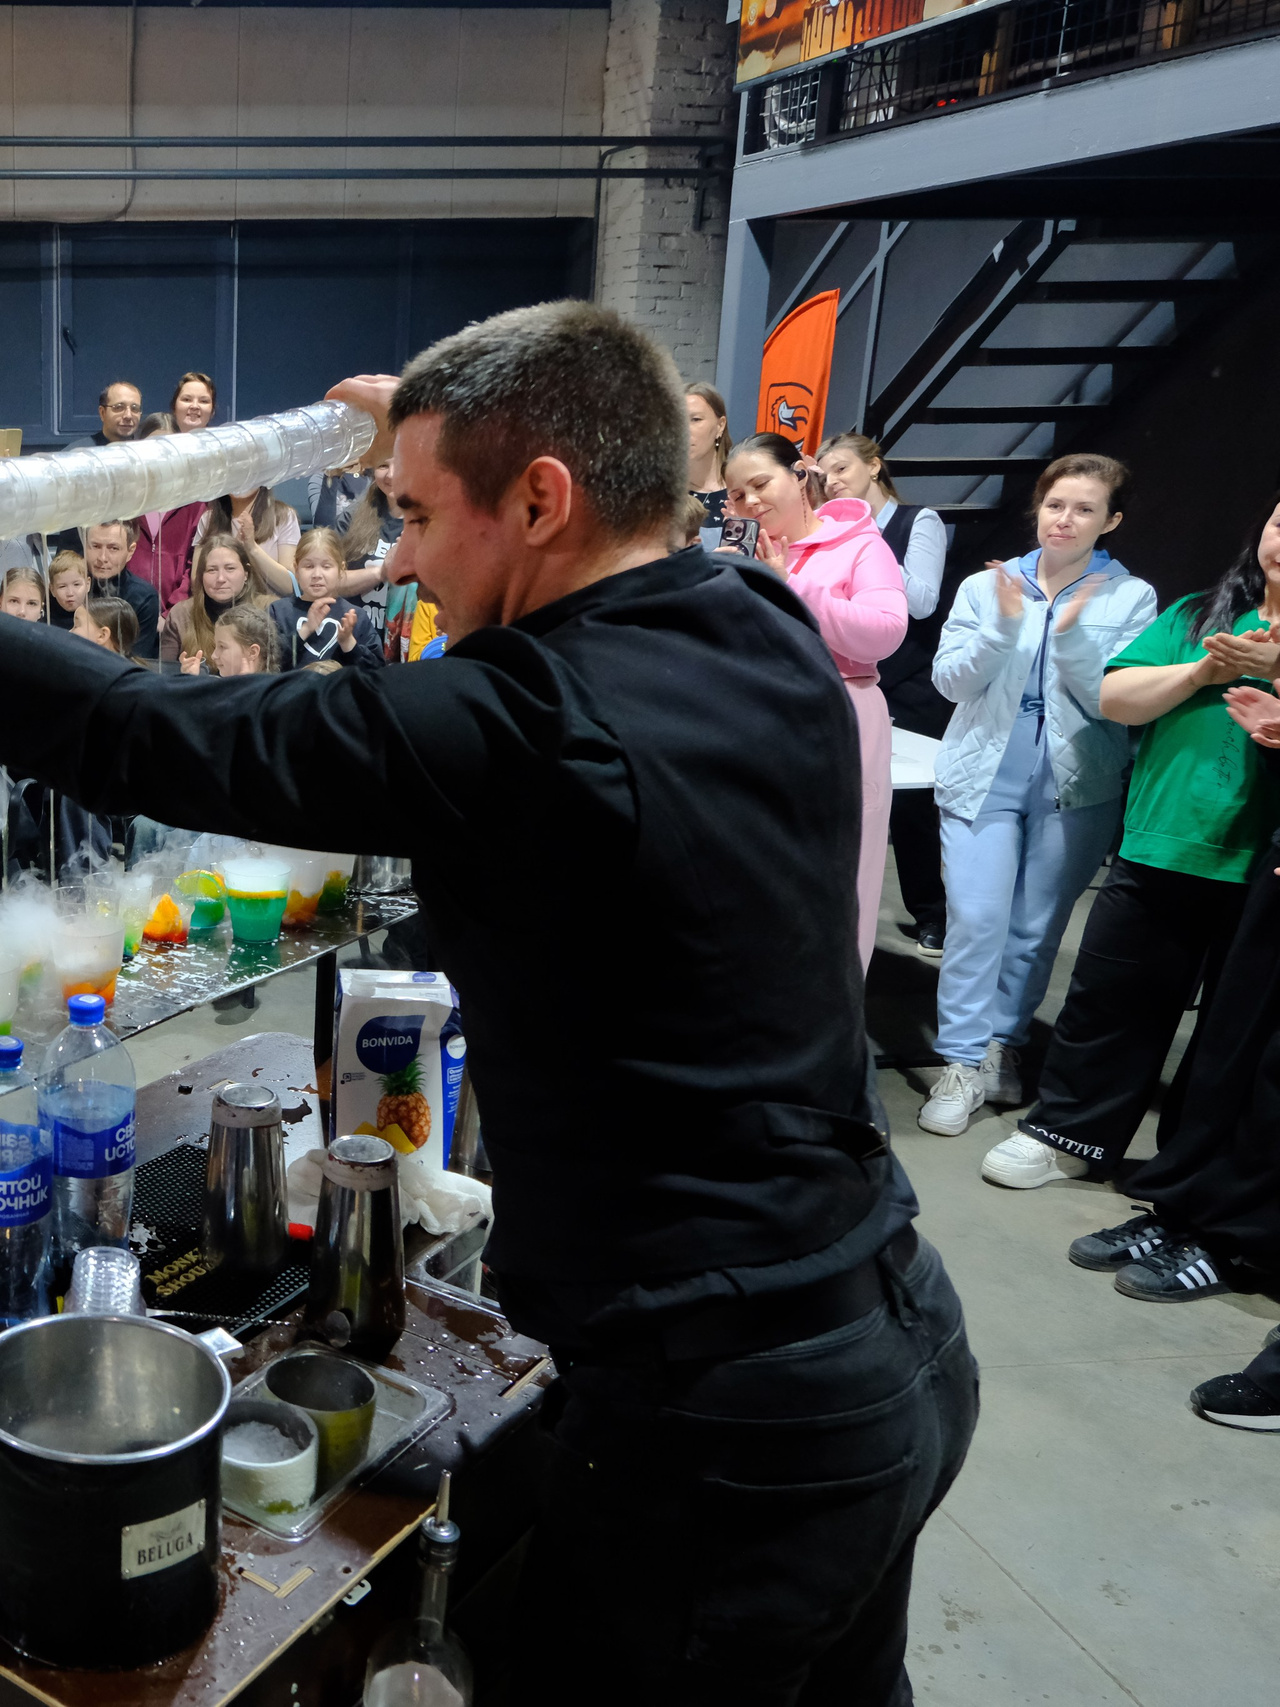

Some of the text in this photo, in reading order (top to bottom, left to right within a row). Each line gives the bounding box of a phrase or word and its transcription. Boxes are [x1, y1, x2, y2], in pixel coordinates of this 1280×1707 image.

[362, 1035, 414, 1048] BONVIDA
[144, 1247, 202, 1286] MONK
[156, 1265, 207, 1296] SHOU
[137, 1531, 194, 1566] BELUGA
